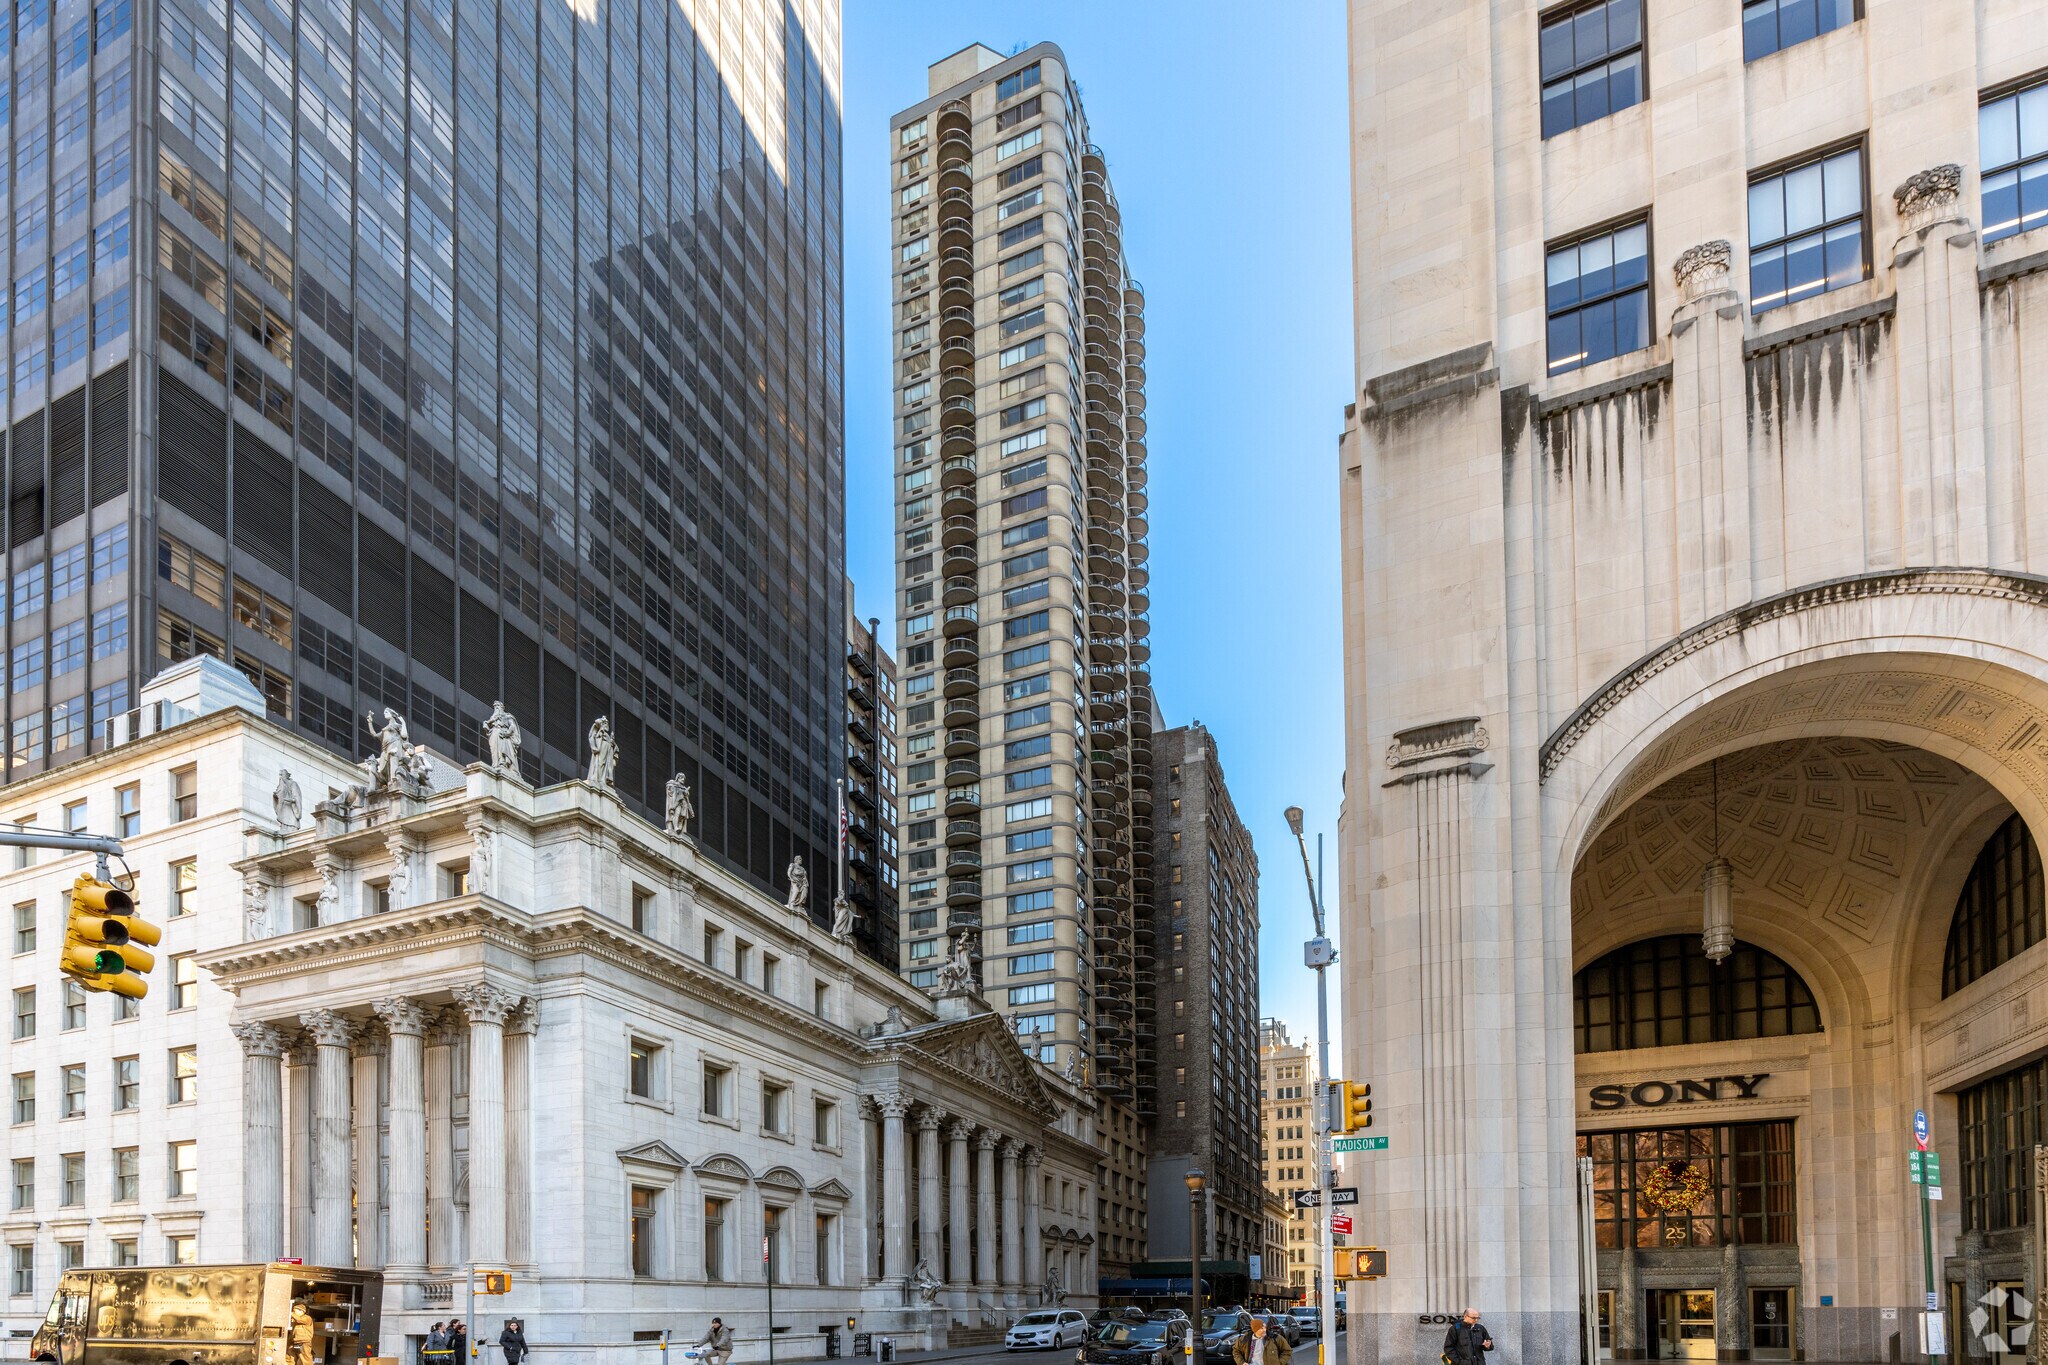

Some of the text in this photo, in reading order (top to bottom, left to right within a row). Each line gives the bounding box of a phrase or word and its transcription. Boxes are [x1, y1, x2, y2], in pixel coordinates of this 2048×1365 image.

[1589, 1073, 1770, 1110] SONY
[1335, 1139, 1375, 1151] MADISON
[1304, 1193, 1350, 1203] ONE WAY
[1665, 1227, 1686, 1239] 25
[100, 1314, 114, 1330] ups
[1419, 1314, 1464, 1325] SON
